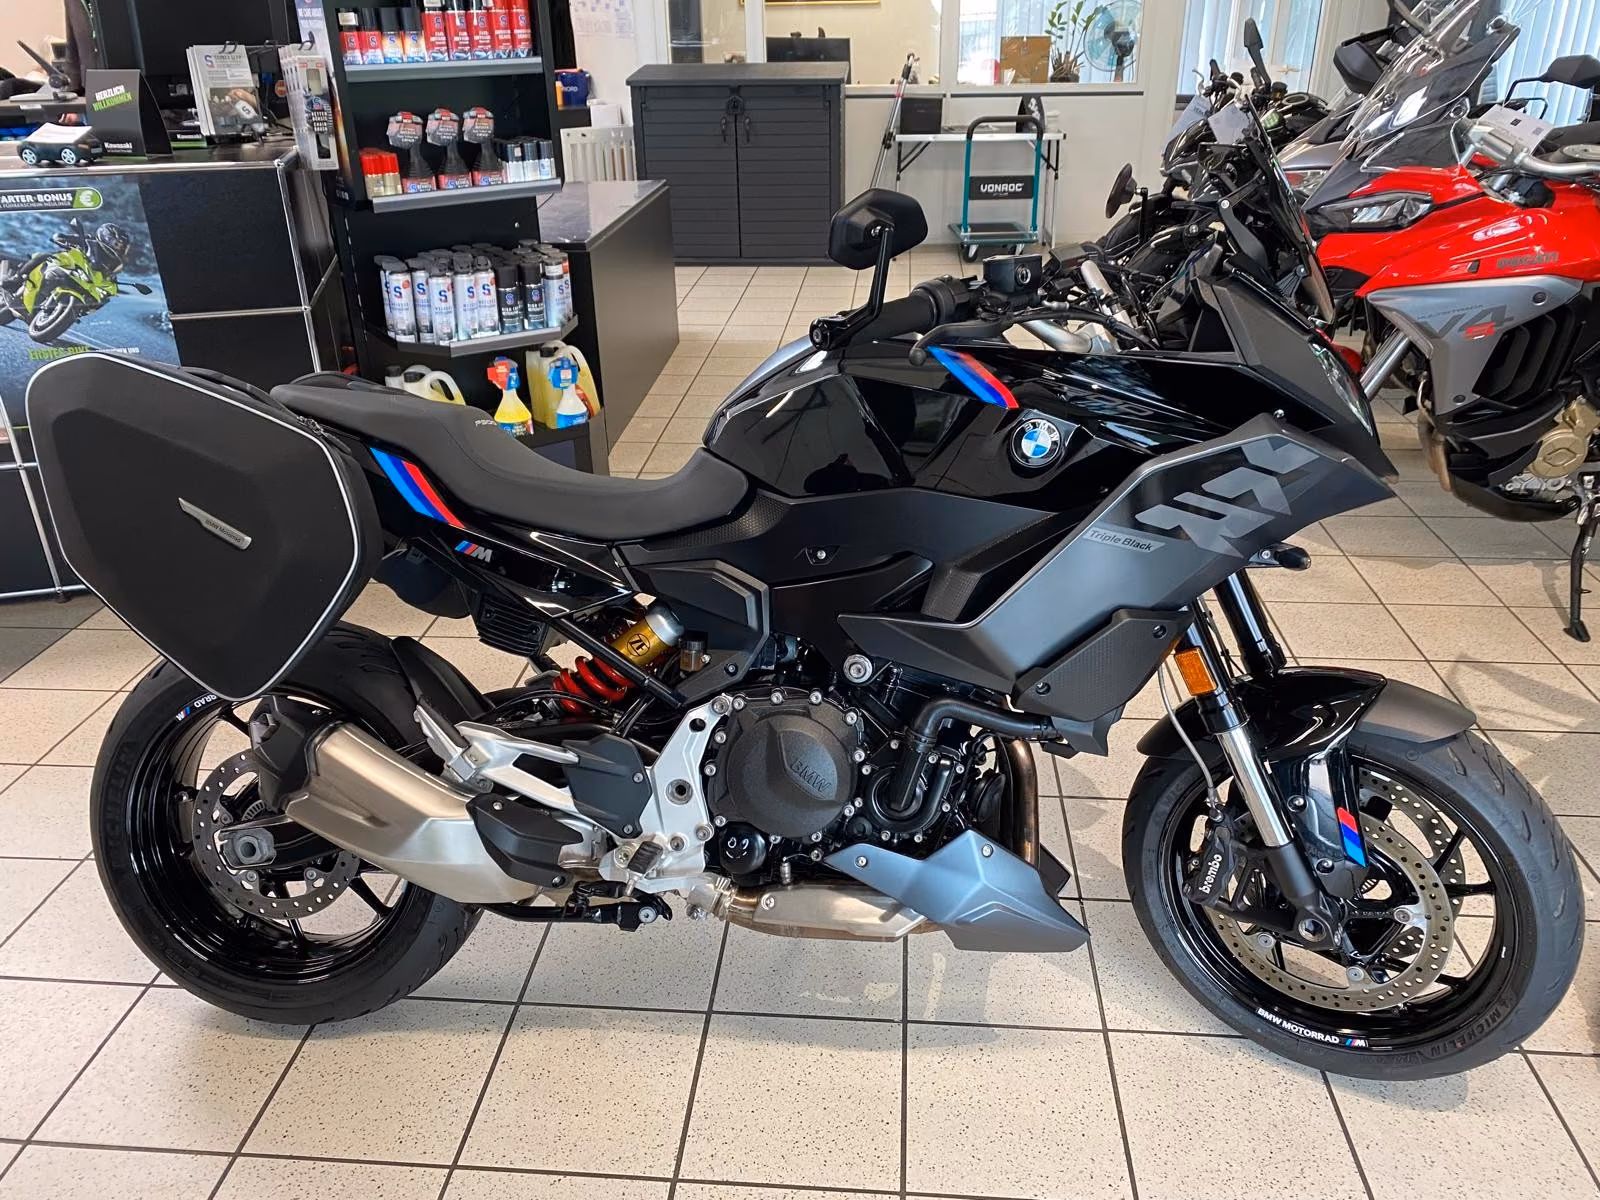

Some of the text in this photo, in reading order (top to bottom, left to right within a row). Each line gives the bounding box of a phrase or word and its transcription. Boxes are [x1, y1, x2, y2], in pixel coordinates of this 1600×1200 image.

[980, 182, 1025, 193] VONROC
[1497, 252, 1559, 269] DUCATI
[1090, 529, 1153, 551] Triple Black
[790, 760, 832, 793] BMW
[1198, 854, 1223, 895] brembo
[1257, 1007, 1282, 1025] BMW
[1281, 1019, 1341, 1044] MOTORRAD
[1430, 1007, 1502, 1057] MICHELIN
